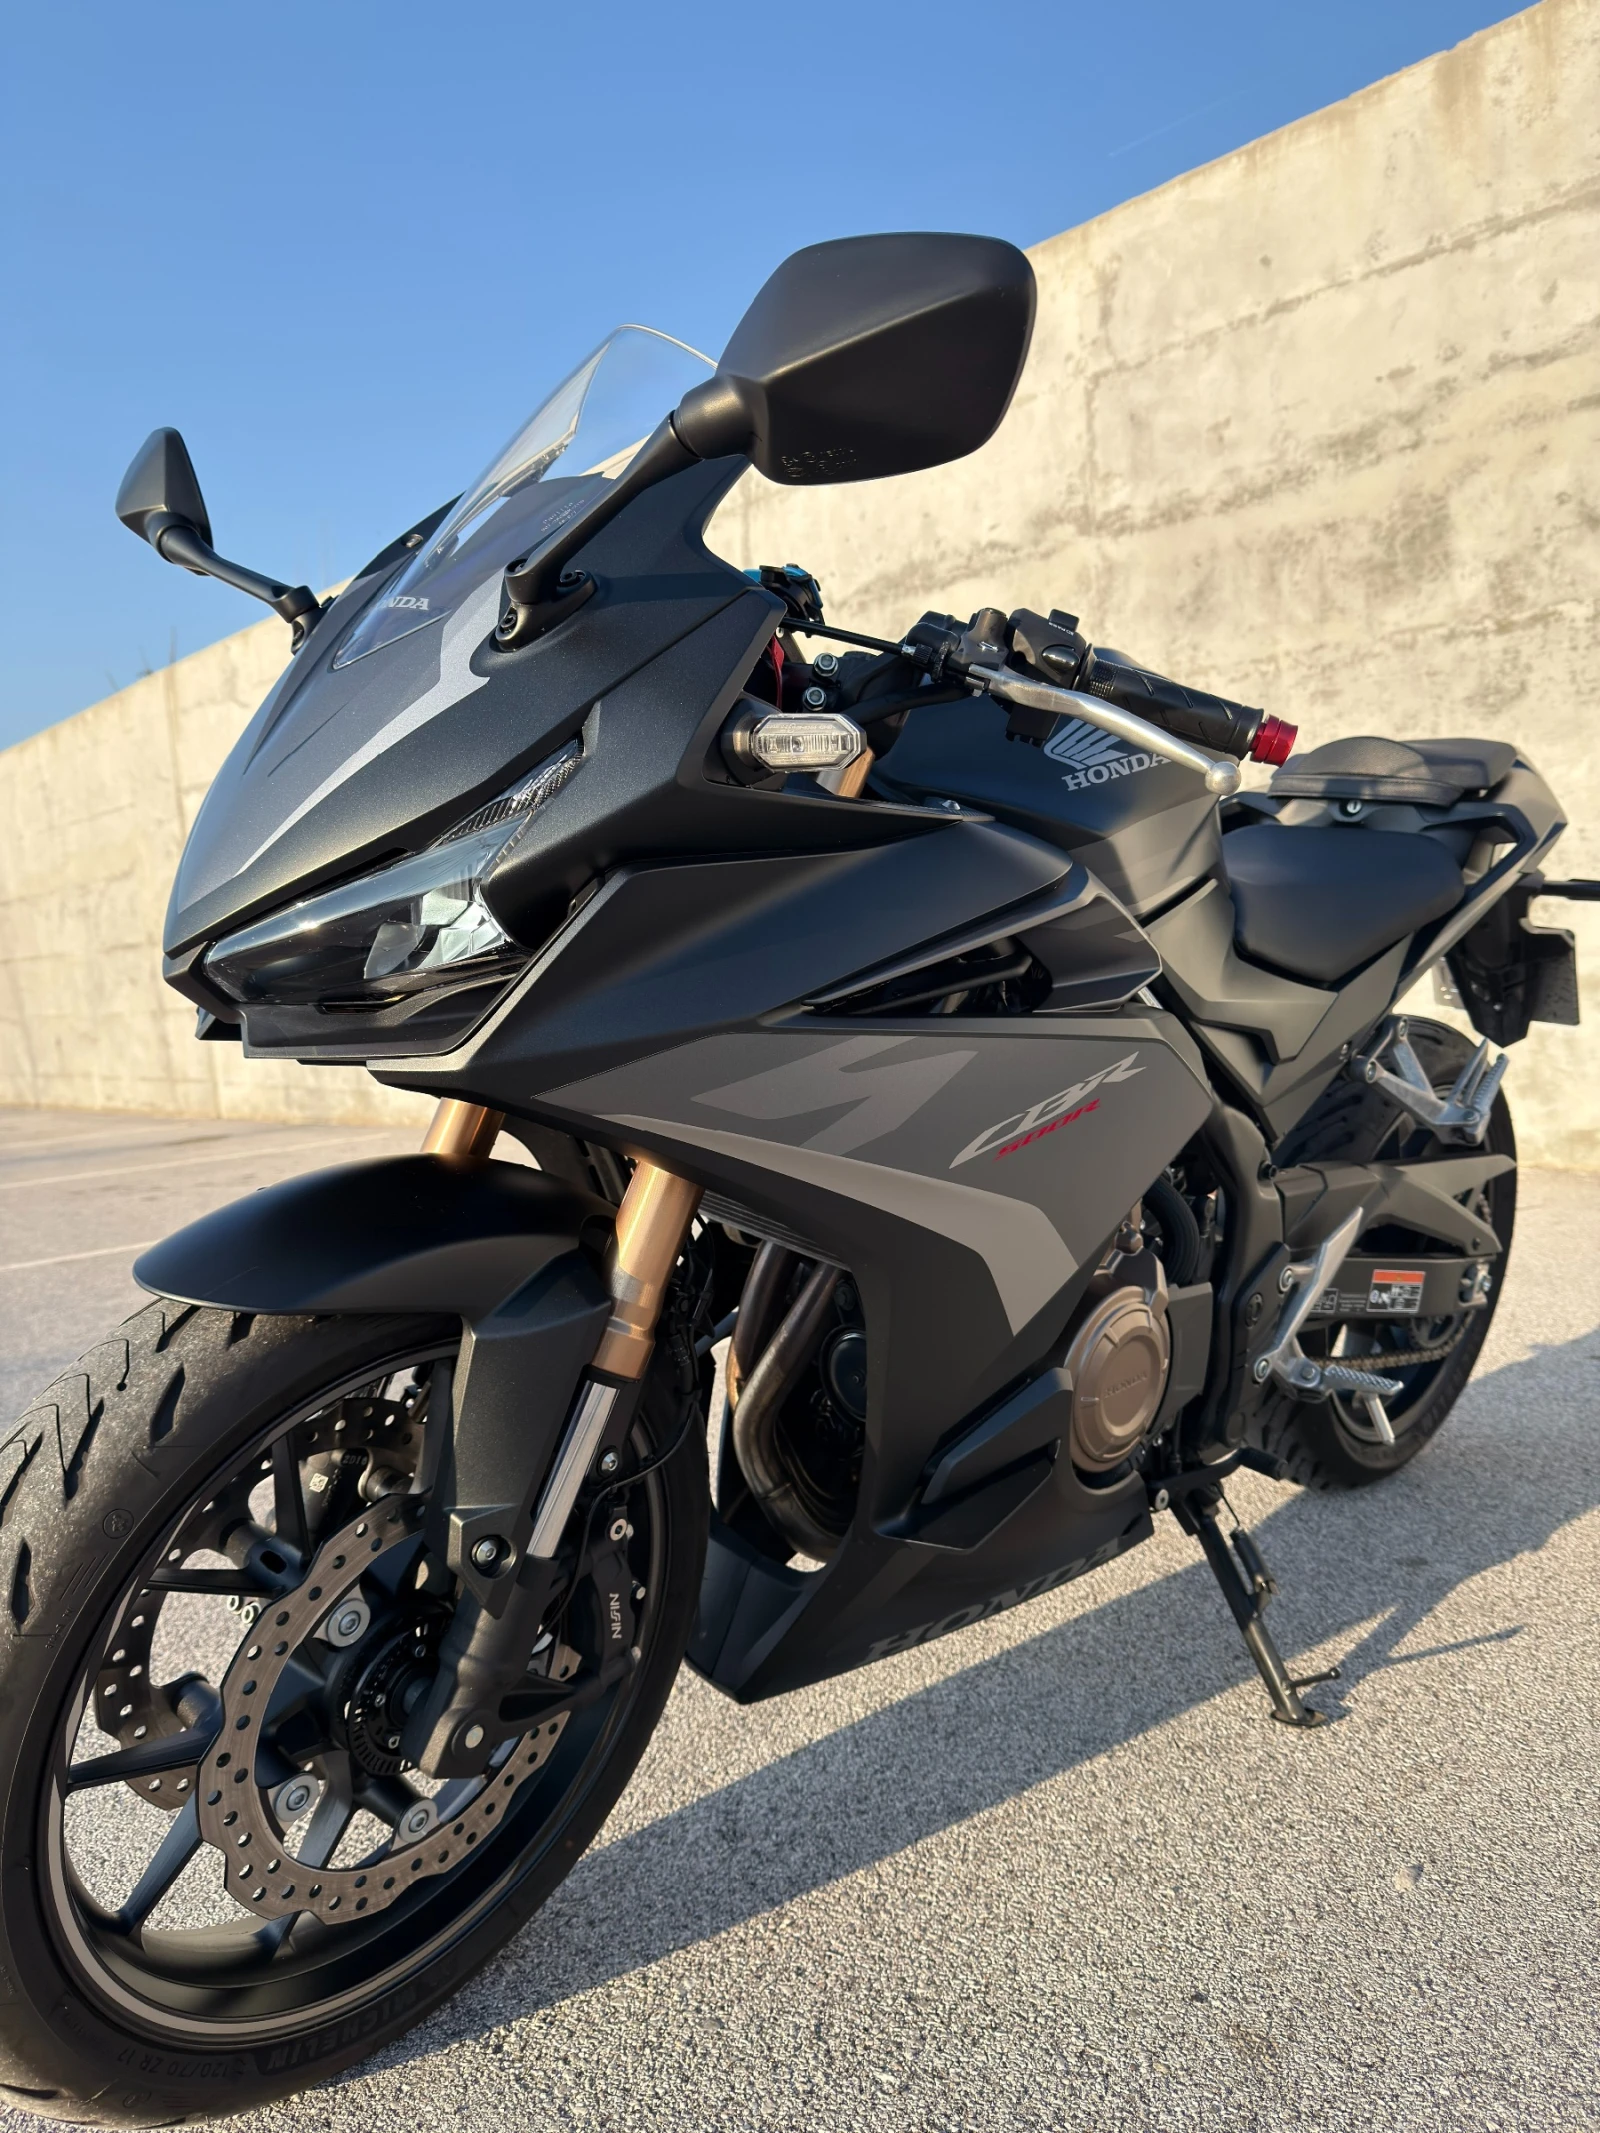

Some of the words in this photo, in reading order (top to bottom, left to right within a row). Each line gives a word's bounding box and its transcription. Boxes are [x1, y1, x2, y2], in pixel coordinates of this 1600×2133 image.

[1061, 752, 1172, 791] HONDA
[949, 1051, 1147, 1170] CBR
[992, 1098, 1101, 1163] 500R
[609, 1593, 622, 1639] NISSIN
[266, 1986, 416, 2070] MICHELIN
